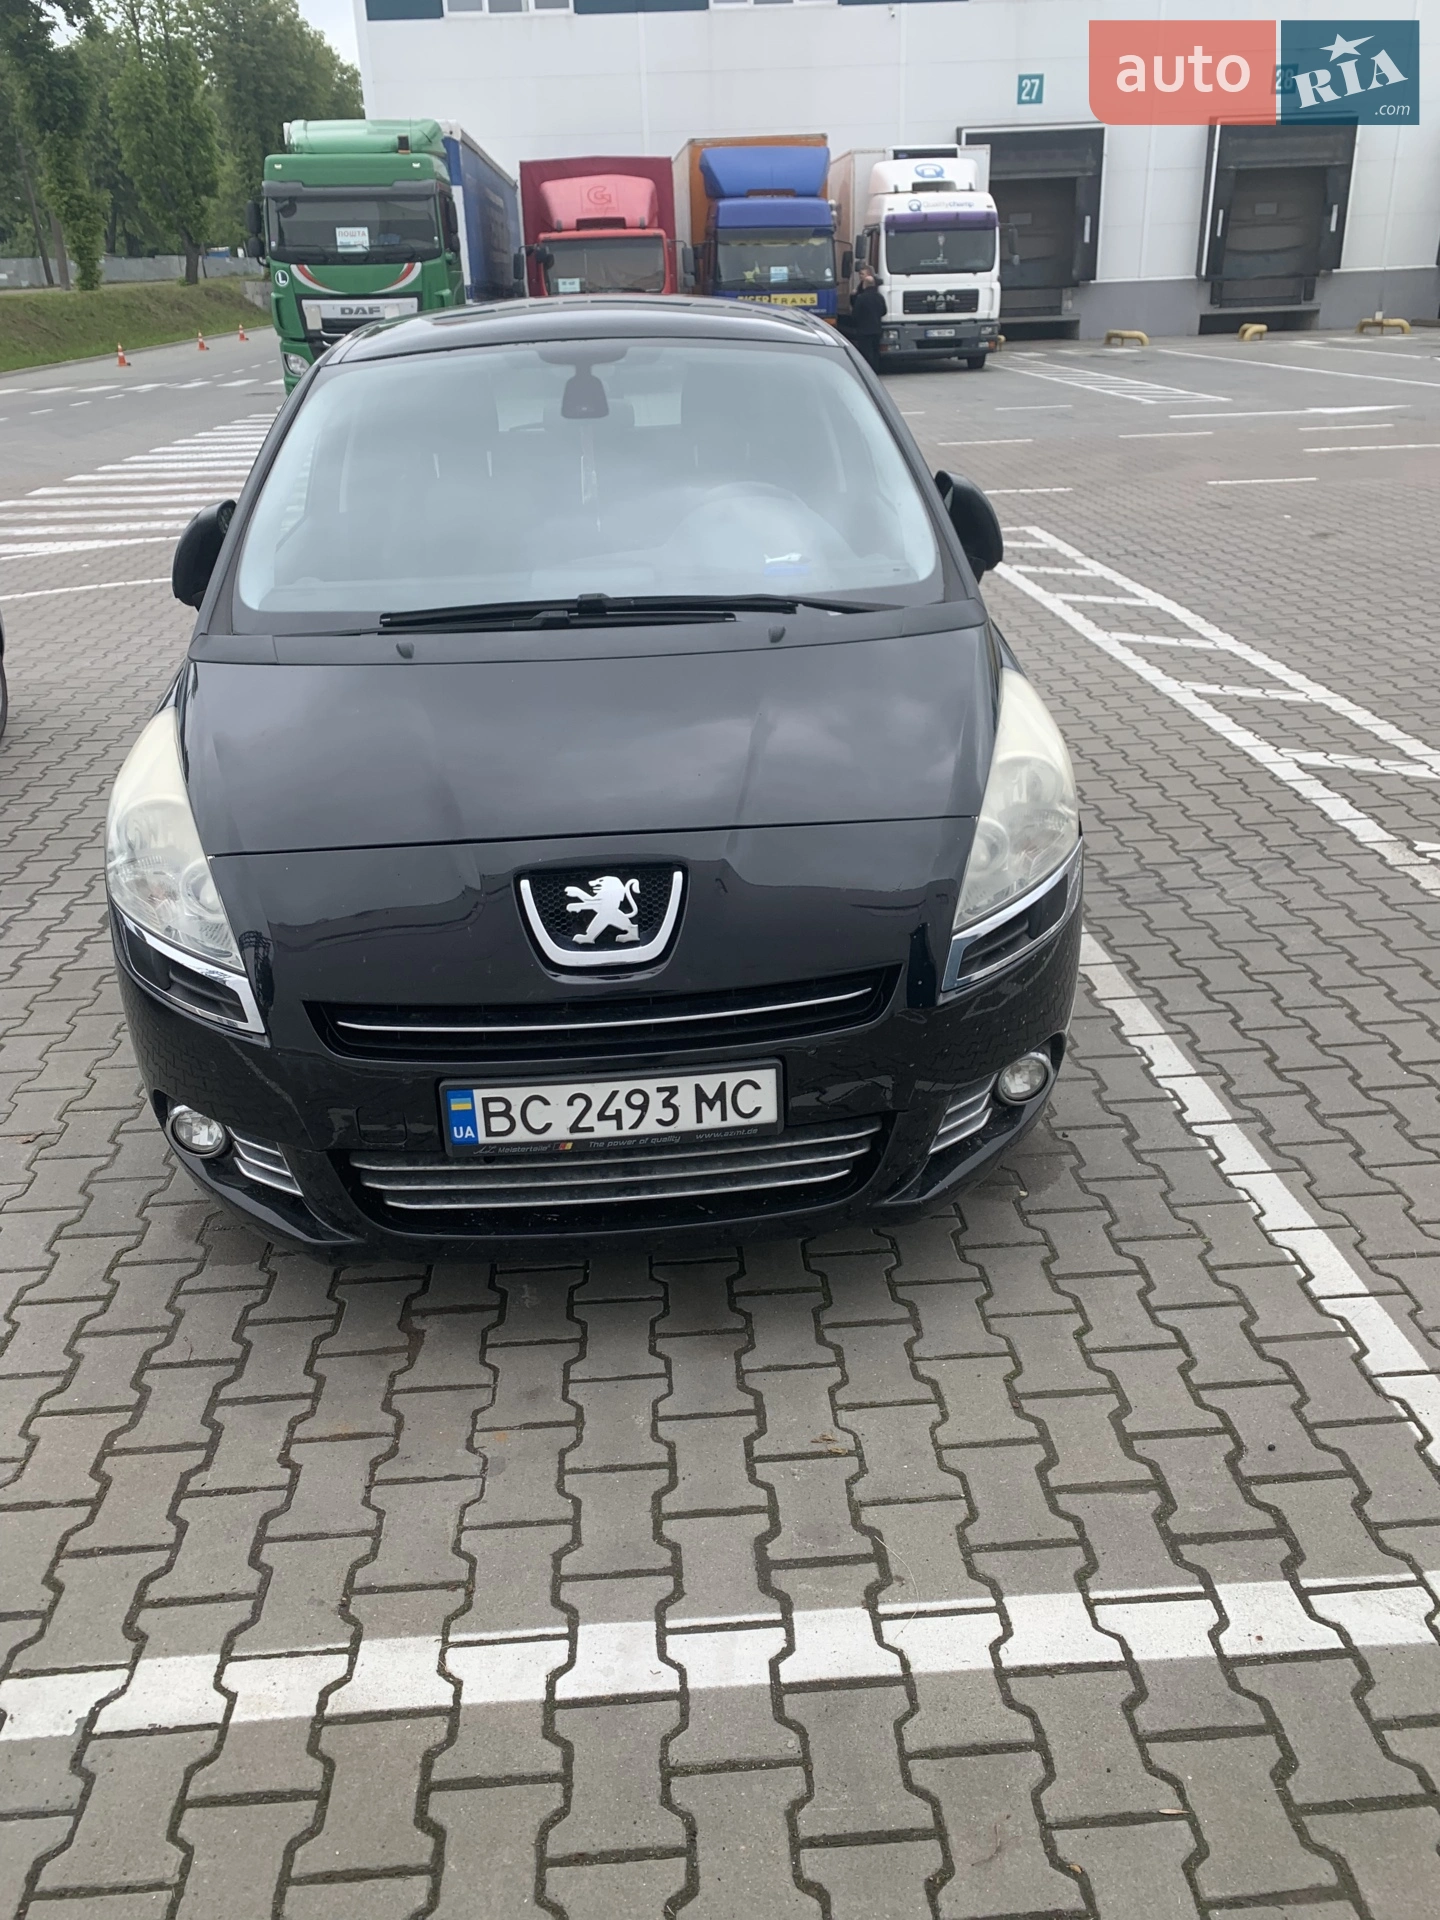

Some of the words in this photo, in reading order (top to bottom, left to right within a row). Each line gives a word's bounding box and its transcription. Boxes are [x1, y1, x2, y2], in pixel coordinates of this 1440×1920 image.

[1020, 78, 1040, 101] 27
[338, 230, 367, 238] ПОШТА
[772, 296, 817, 305] TRANS
[926, 294, 956, 302] MAN
[340, 306, 382, 316] DAF
[481, 1094, 553, 1138] BC
[566, 1085, 680, 1134] 2493
[694, 1079, 763, 1124] MC
[453, 1125, 476, 1140] UA
[588, 1141, 605, 1149] The
[607, 1140, 637, 1149] power
[639, 1137, 649, 1145] of
[651, 1134, 681, 1145] quality
